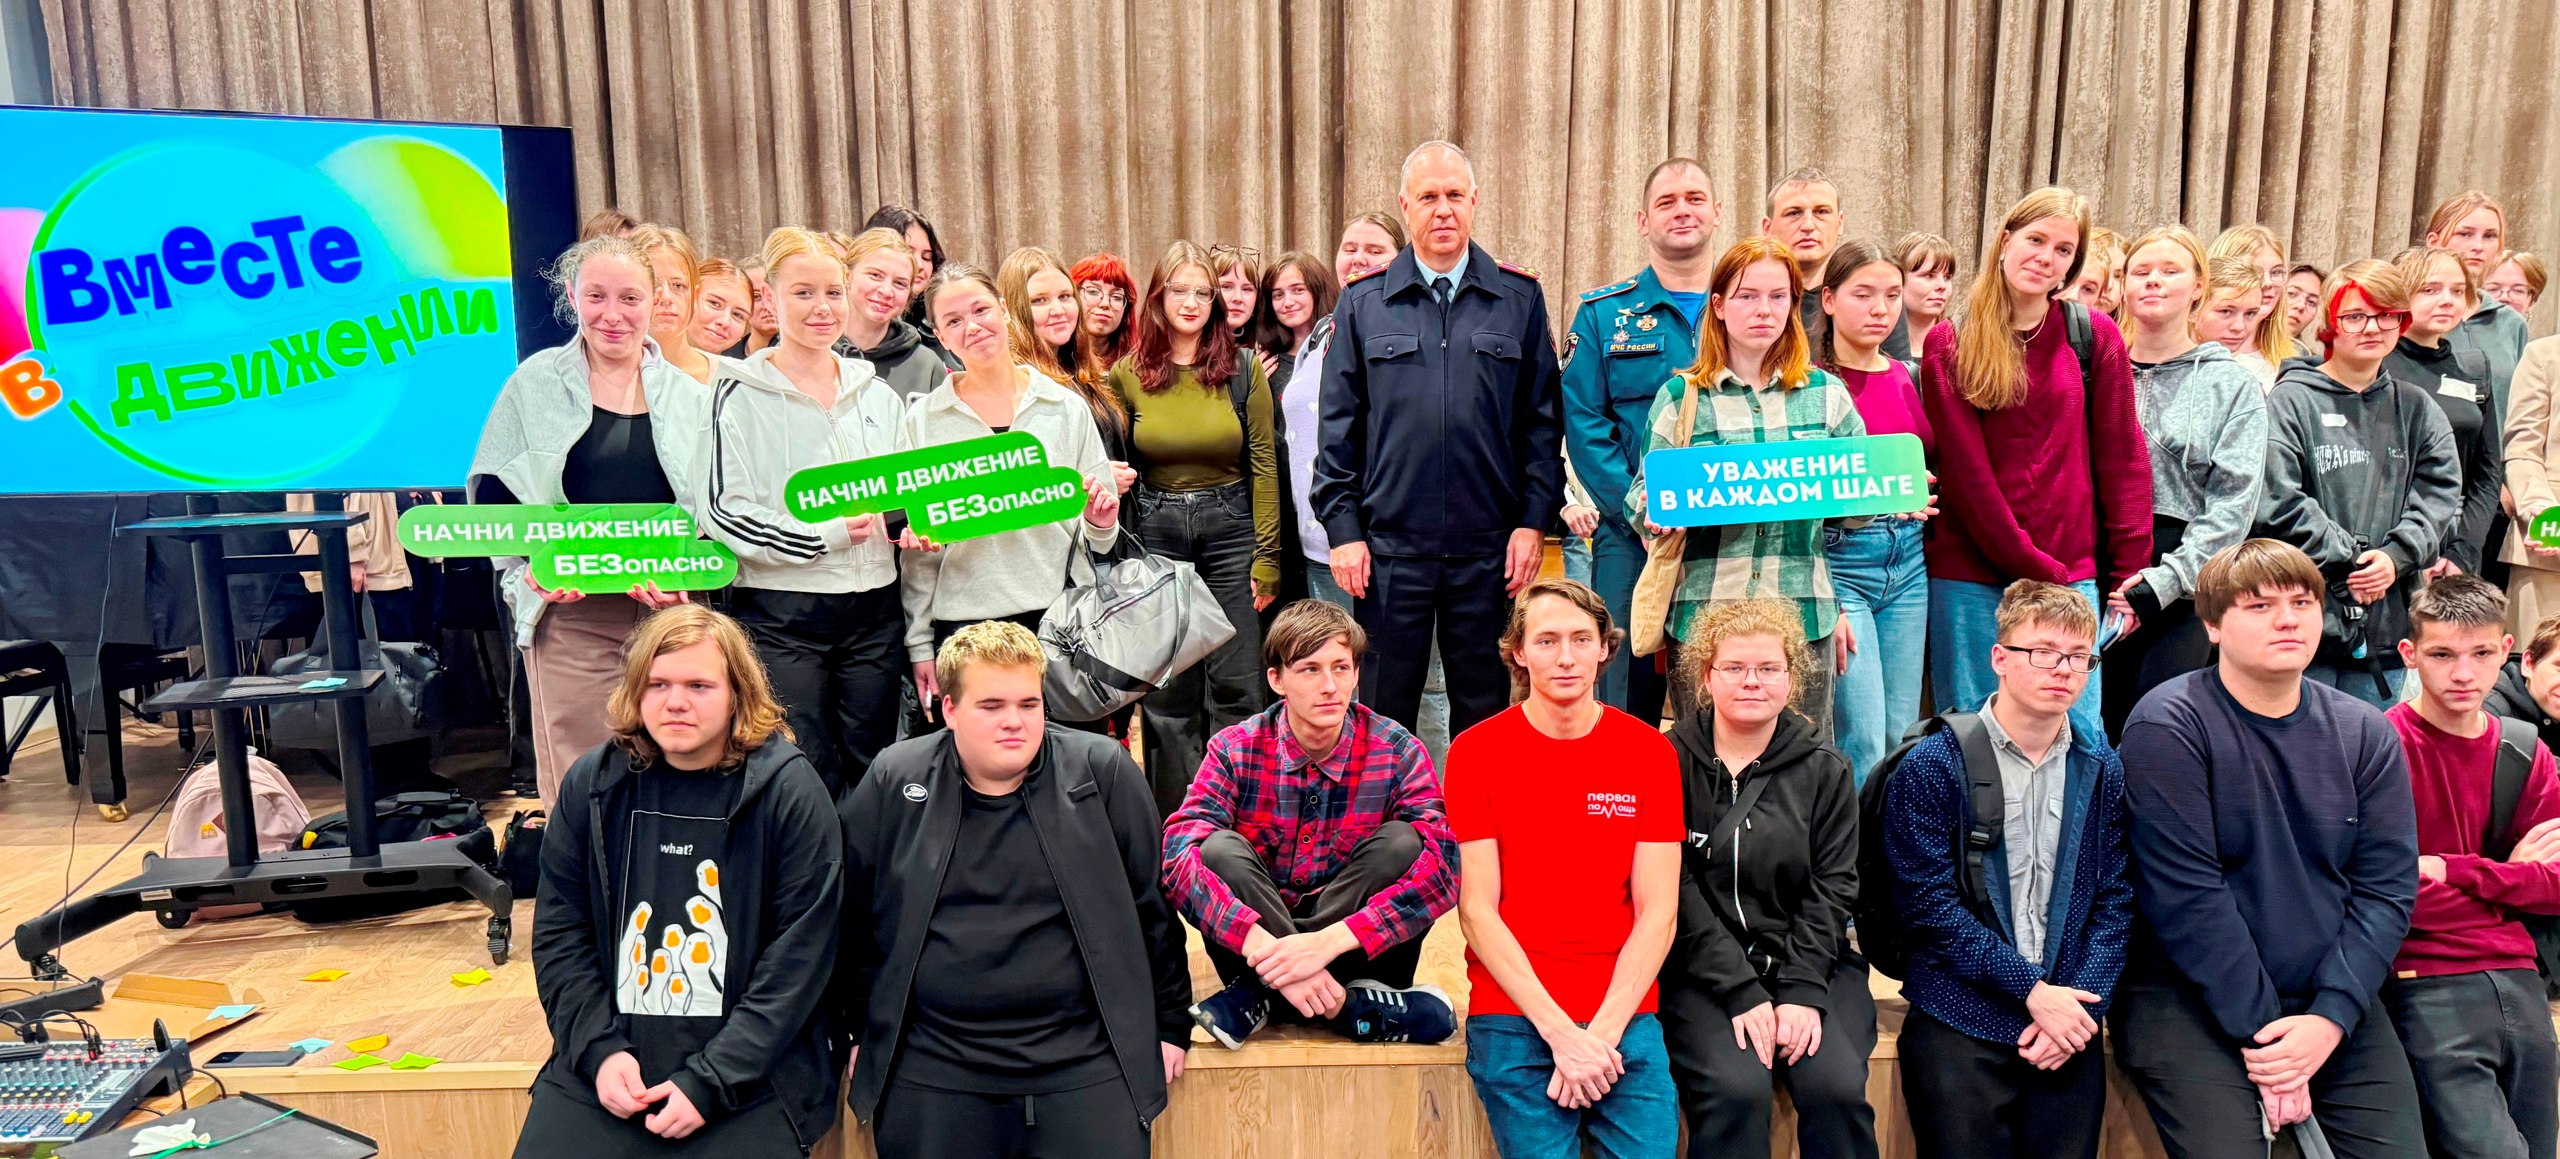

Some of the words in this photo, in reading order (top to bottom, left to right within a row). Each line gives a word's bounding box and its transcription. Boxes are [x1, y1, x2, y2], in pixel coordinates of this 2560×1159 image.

[797, 476, 888, 510] НАЧНИ
[896, 445, 1041, 495] ДВИЖЕНИЕ
[1702, 452, 1867, 483] УВАЖЕНИЕ
[1660, 490, 1678, 511] В
[1687, 480, 1823, 509] КАЖДОМ
[1832, 473, 1915, 500] ШАГЕ
[413, 522, 515, 542] НАЧНИ
[523, 519, 690, 544] ДВИЖЕНИЕ
[1587, 792, 1636, 804] первая
[660, 842, 694, 855] what?
